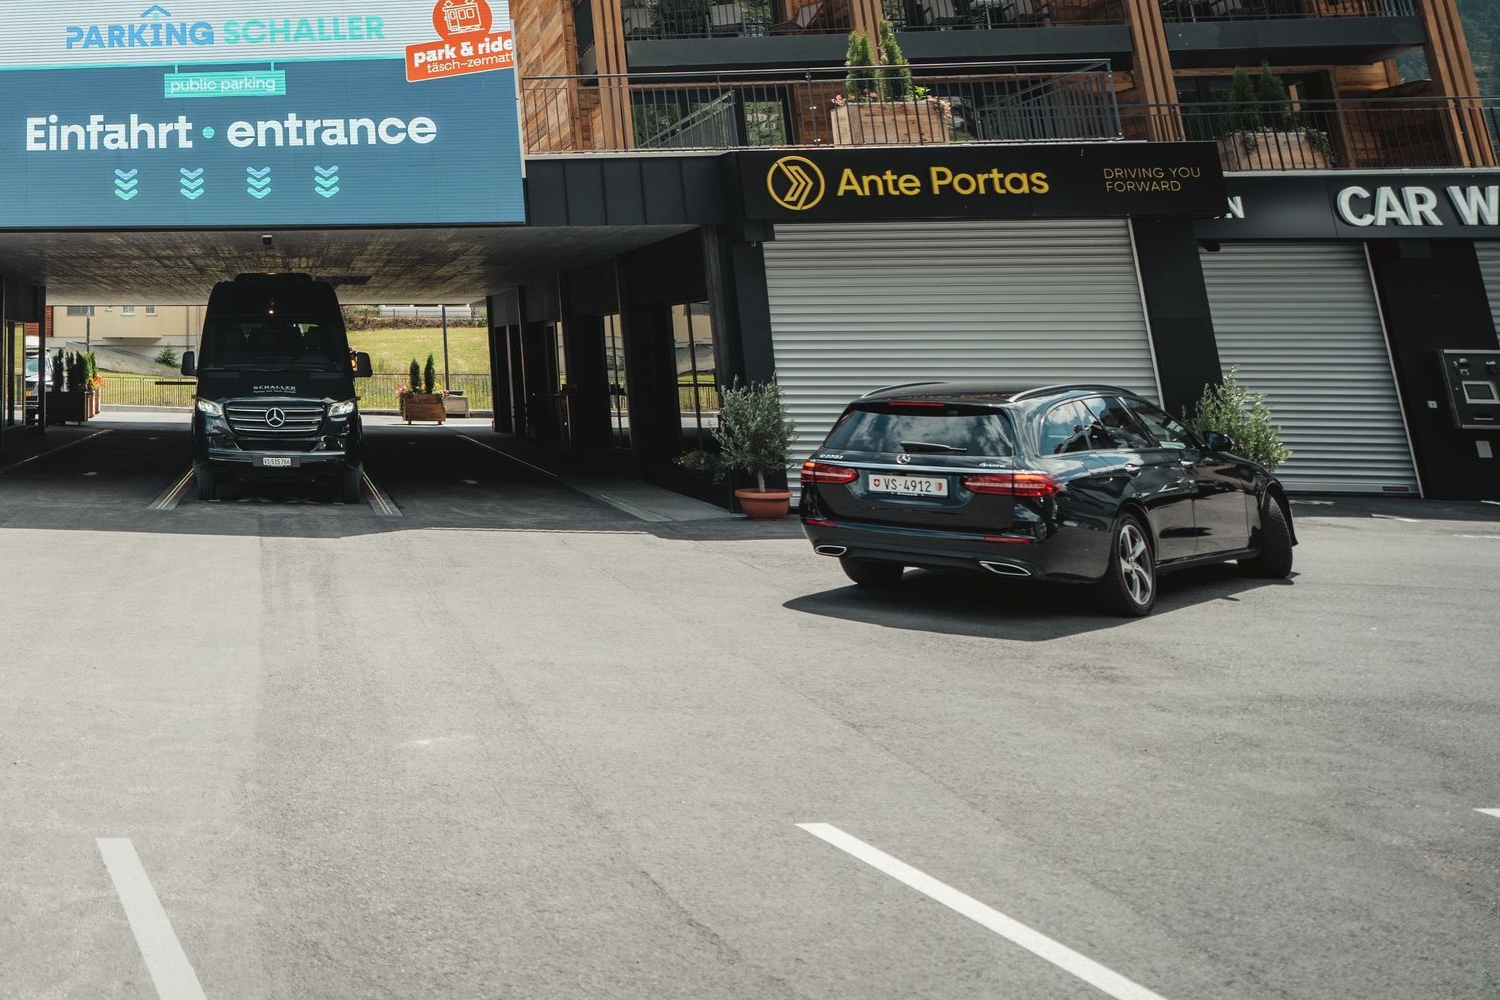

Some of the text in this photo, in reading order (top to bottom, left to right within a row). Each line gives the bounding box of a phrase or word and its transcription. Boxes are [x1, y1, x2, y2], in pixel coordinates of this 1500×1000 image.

[66, 15, 384, 49] PARKING SCHALLER
[413, 36, 513, 68] park & ride
[170, 75, 276, 95] public parking
[26, 112, 437, 151] Einfahrt entrance
[836, 165, 1050, 197] Ante Portas
[1103, 166, 1201, 179] DRIVING YOU
[1105, 180, 1181, 192] FORWARD
[1336, 185, 1500, 227] CAR W
